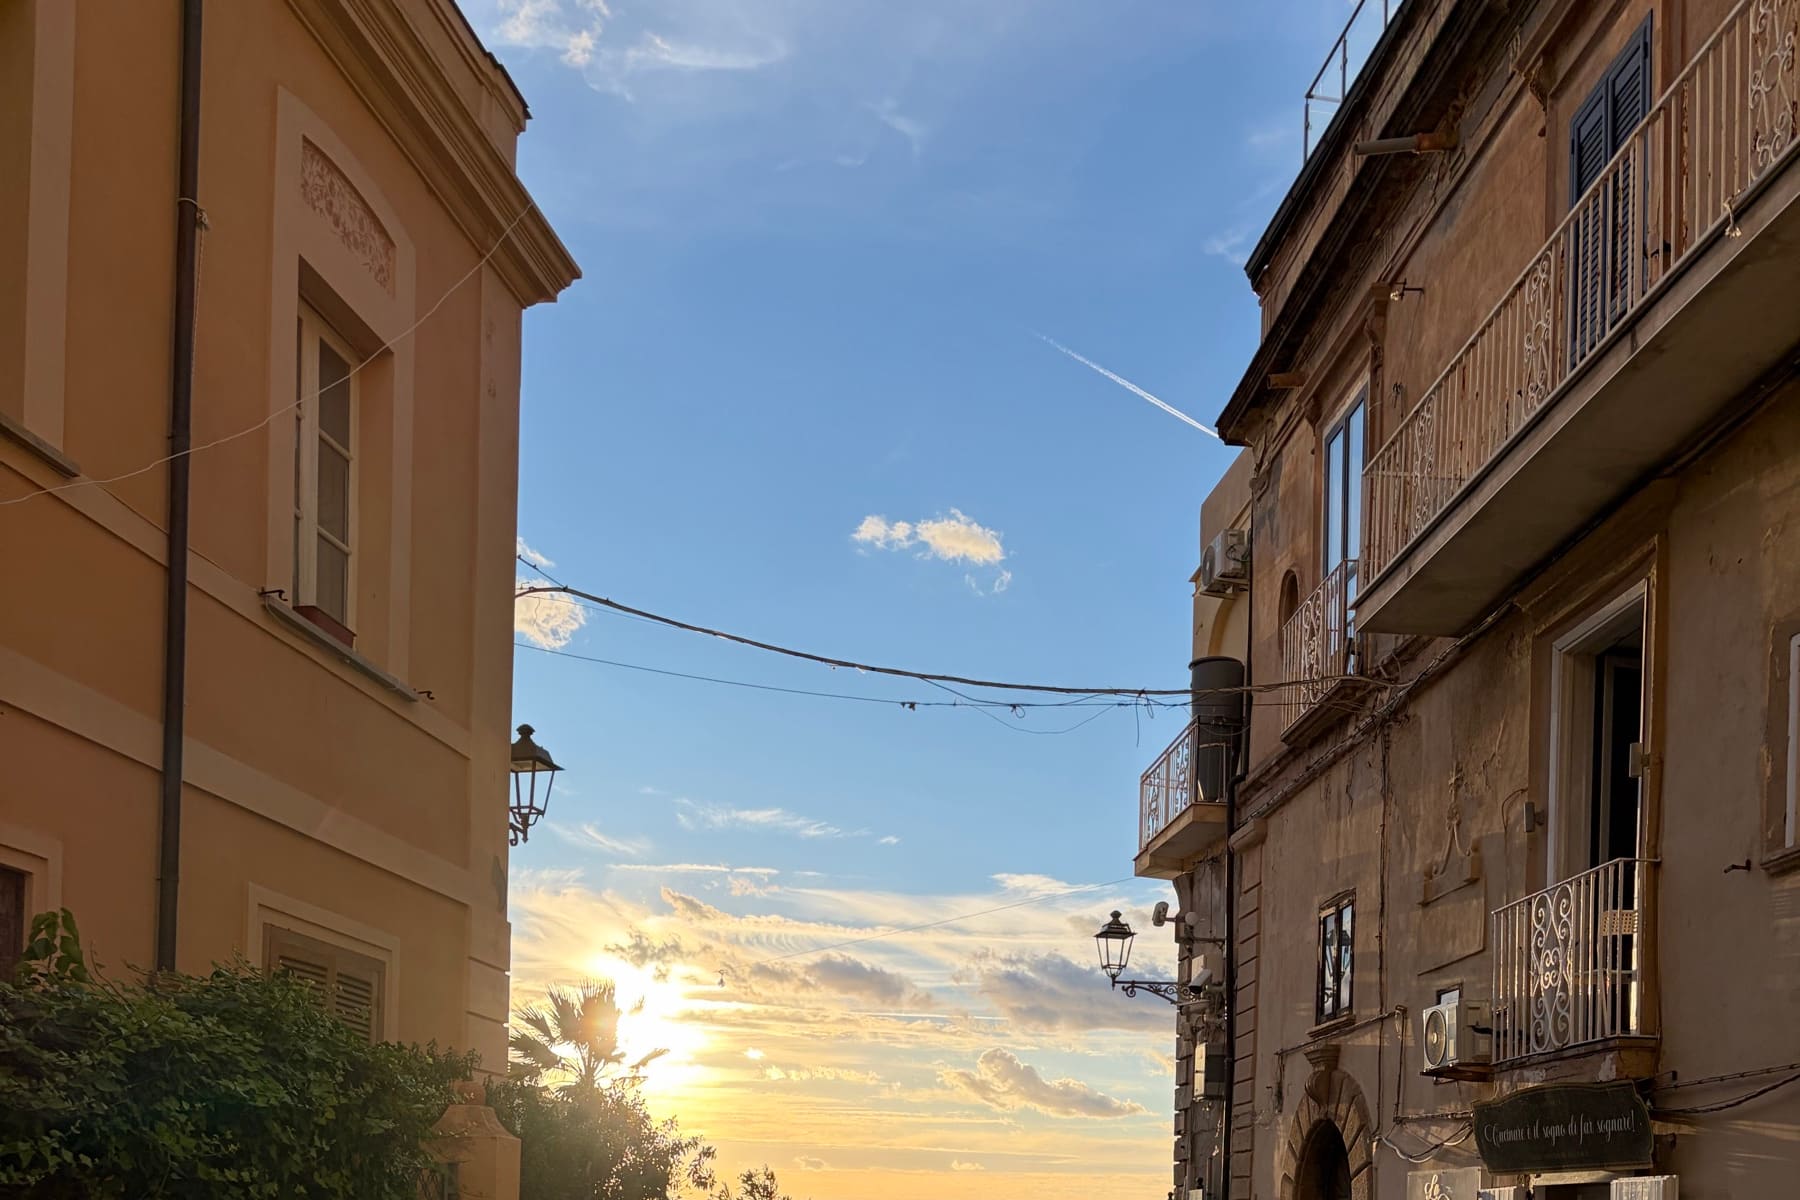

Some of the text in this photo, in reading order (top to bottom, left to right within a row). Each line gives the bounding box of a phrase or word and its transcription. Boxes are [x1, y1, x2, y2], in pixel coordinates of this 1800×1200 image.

[1484, 1123, 1524, 1148] Cucinare
[1533, 1118, 1540, 1140] il
[1542, 1124, 1567, 1147] sogno
[1568, 1113, 1578, 1137] di
[1579, 1112, 1595, 1145] far
[1596, 1108, 1636, 1142] sognare!
[1424, 1174, 1442, 1200] La
